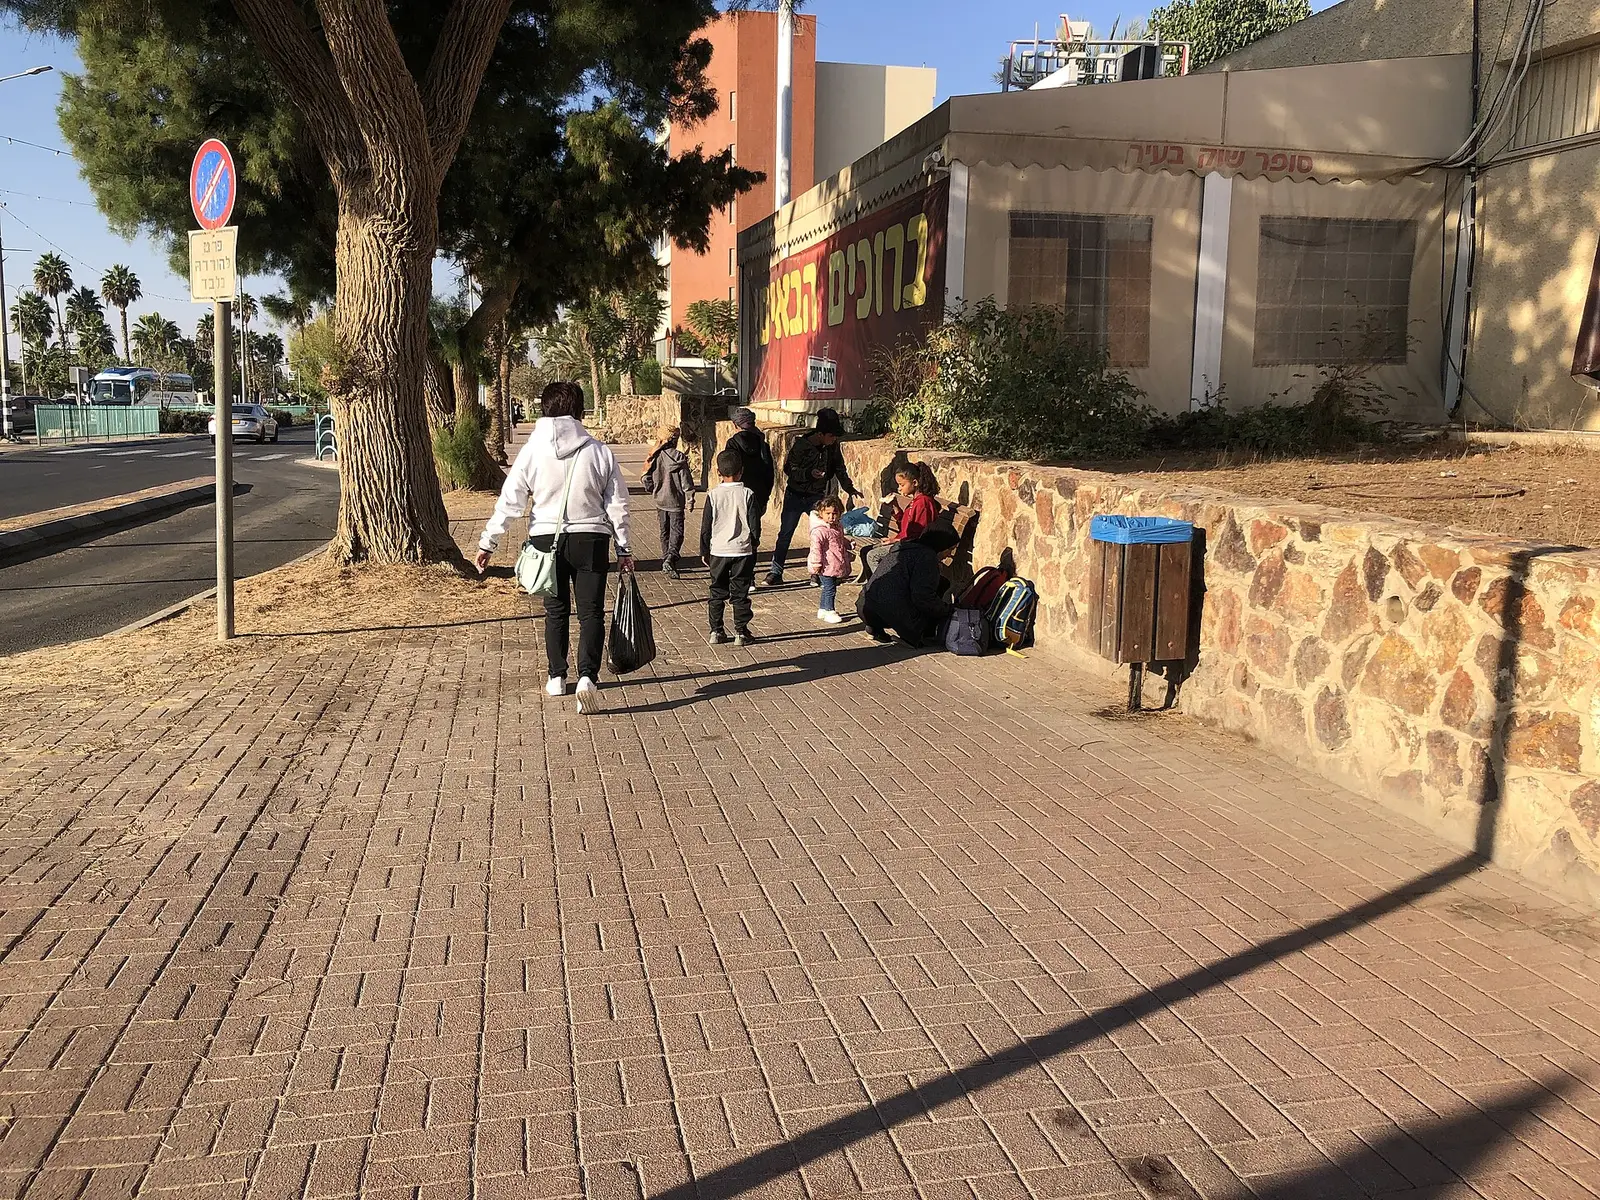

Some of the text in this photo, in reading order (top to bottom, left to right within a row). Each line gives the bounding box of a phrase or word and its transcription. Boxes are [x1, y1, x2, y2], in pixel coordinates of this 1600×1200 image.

[1129, 143, 1314, 174] סופר שוק בעיר
[203, 240, 223, 253] פרט
[194, 255, 231, 272] להורדה
[758, 212, 929, 346] ברוכים הבאים
